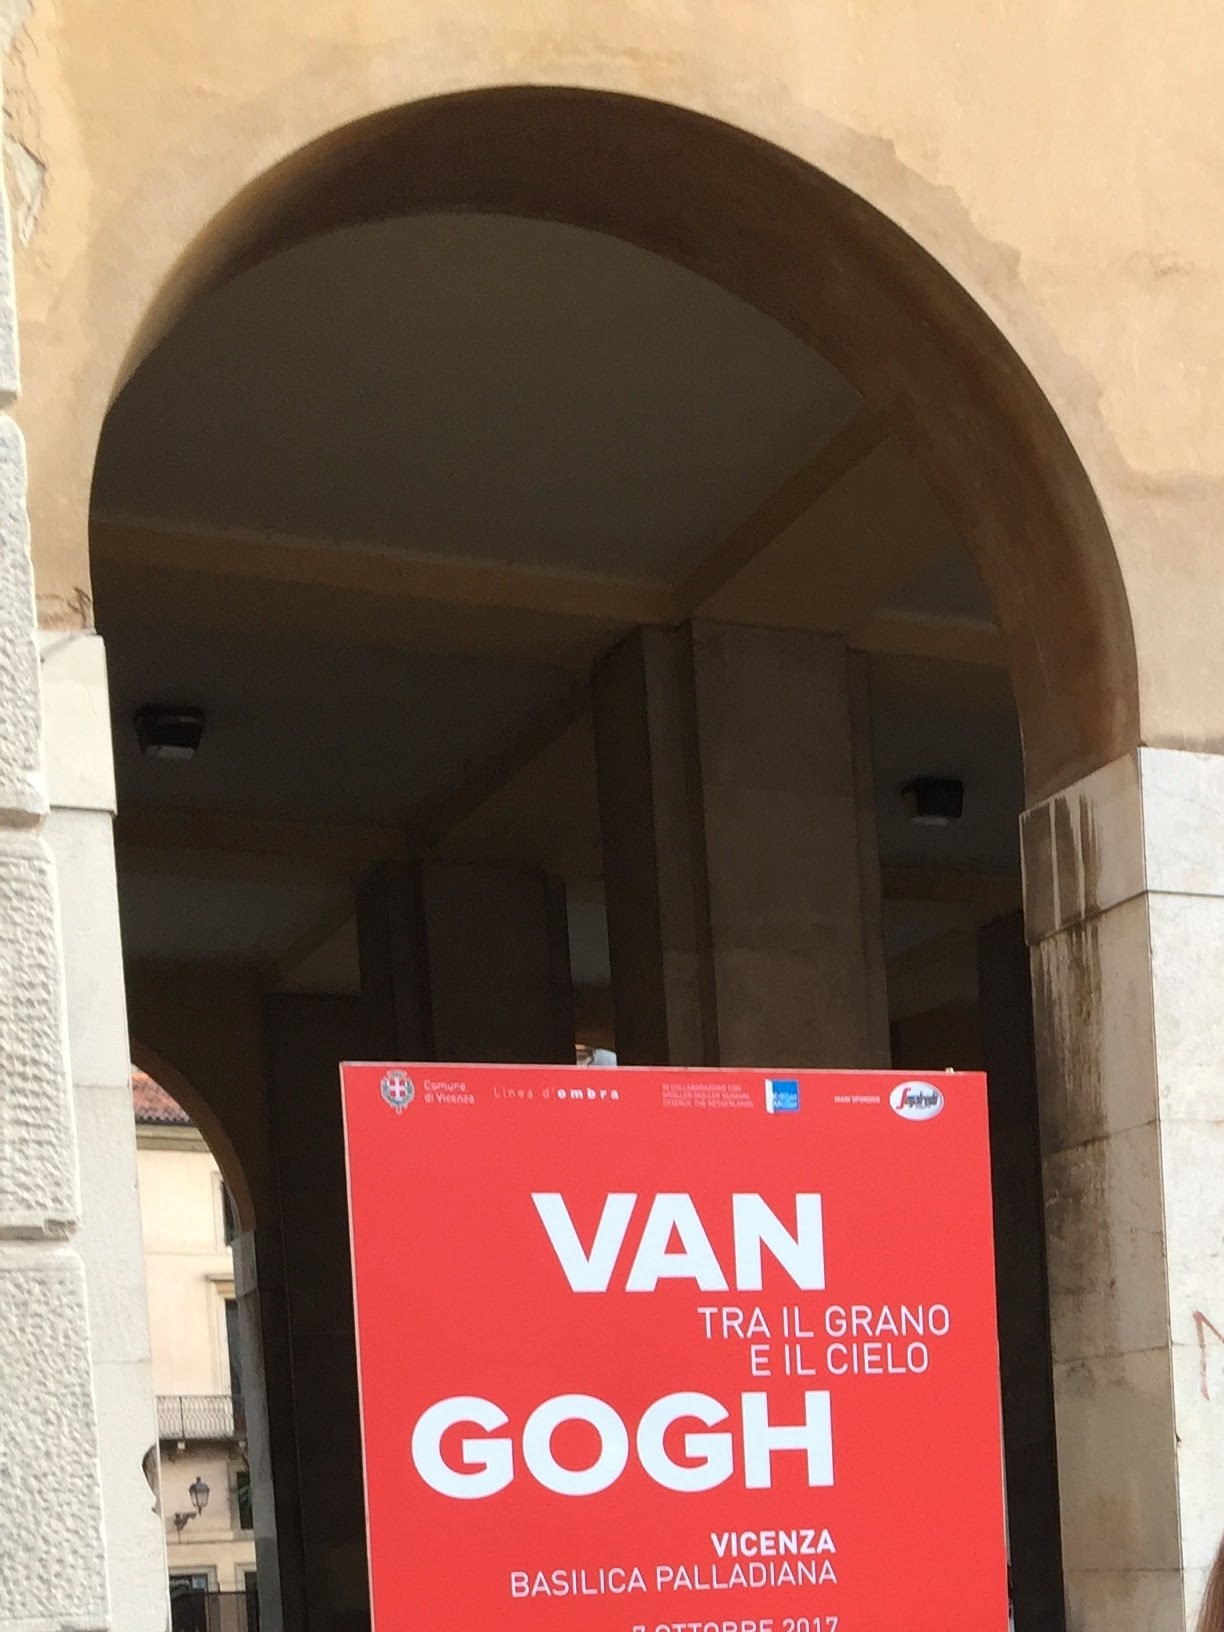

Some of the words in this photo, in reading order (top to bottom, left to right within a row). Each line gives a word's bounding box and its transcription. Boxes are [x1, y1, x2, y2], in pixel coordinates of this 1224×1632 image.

[530, 1191, 826, 1292] VAN
[697, 1306, 772, 1340] TRA
[783, 1305, 815, 1338] IL
[825, 1303, 950, 1338] GRANO
[751, 1343, 771, 1377] E
[784, 1343, 816, 1376] IL
[827, 1341, 929, 1375] CIELO
[411, 1389, 835, 1500] GOGH
[710, 1528, 837, 1558] VICENZA
[510, 1566, 647, 1598] BASILICA
[655, 1559, 838, 1592] PALLADIANA
